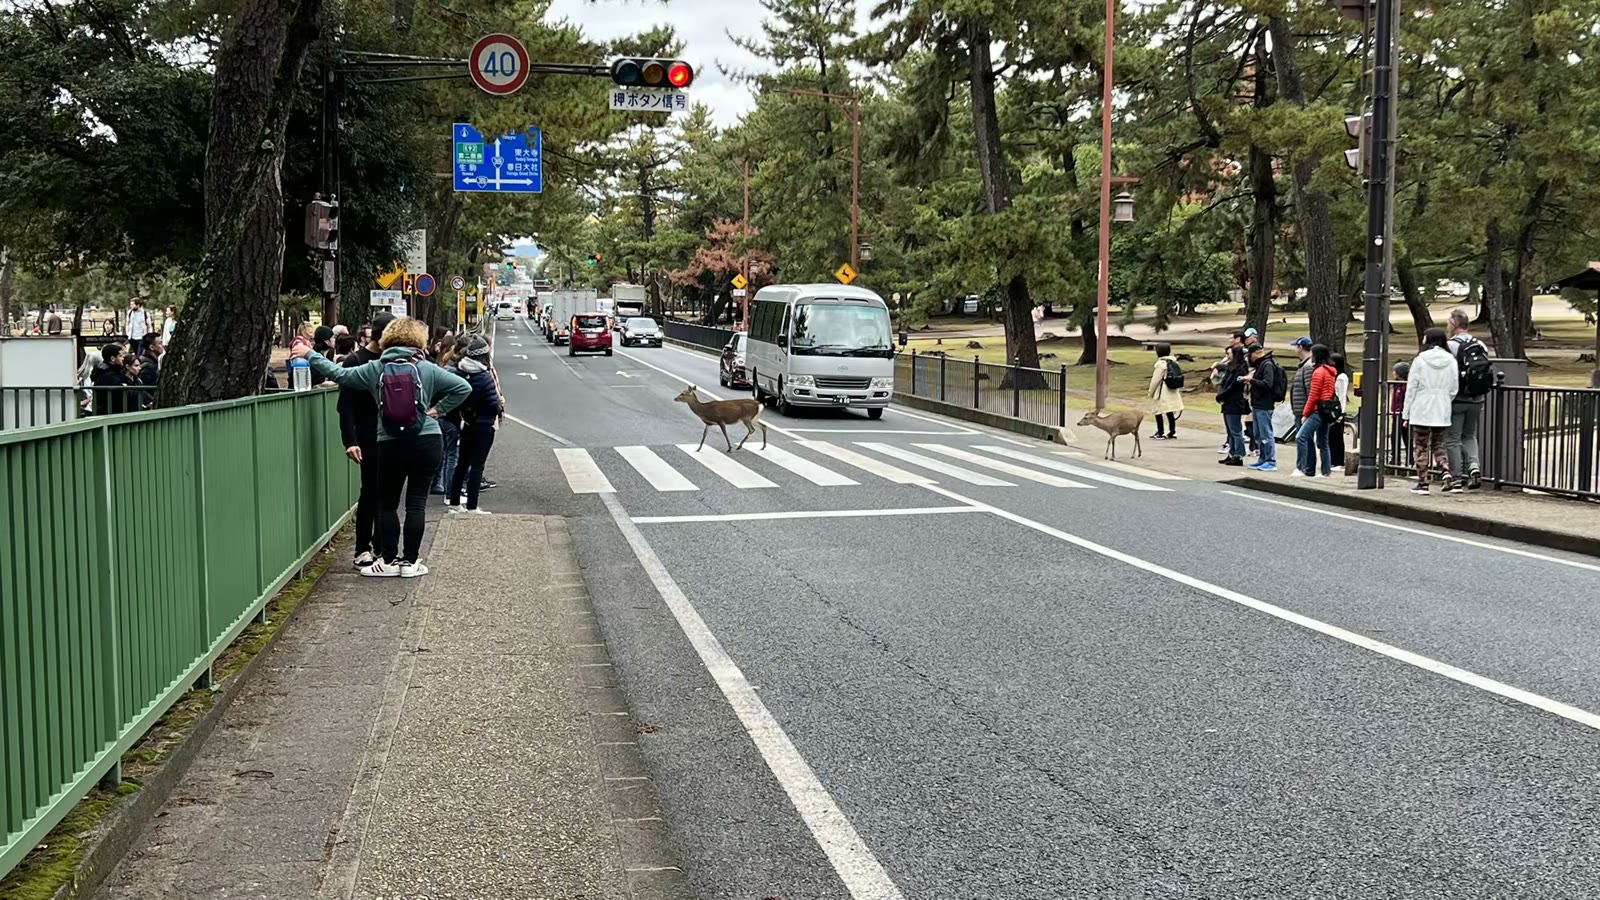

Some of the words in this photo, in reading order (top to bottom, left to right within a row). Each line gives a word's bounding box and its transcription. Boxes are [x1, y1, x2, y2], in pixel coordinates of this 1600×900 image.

[484, 51, 515, 77] 40
[613, 92, 686, 109] 押ボタン信号
[514, 148, 539, 158] 東大寺
[507, 163, 539, 172] 春日大社
